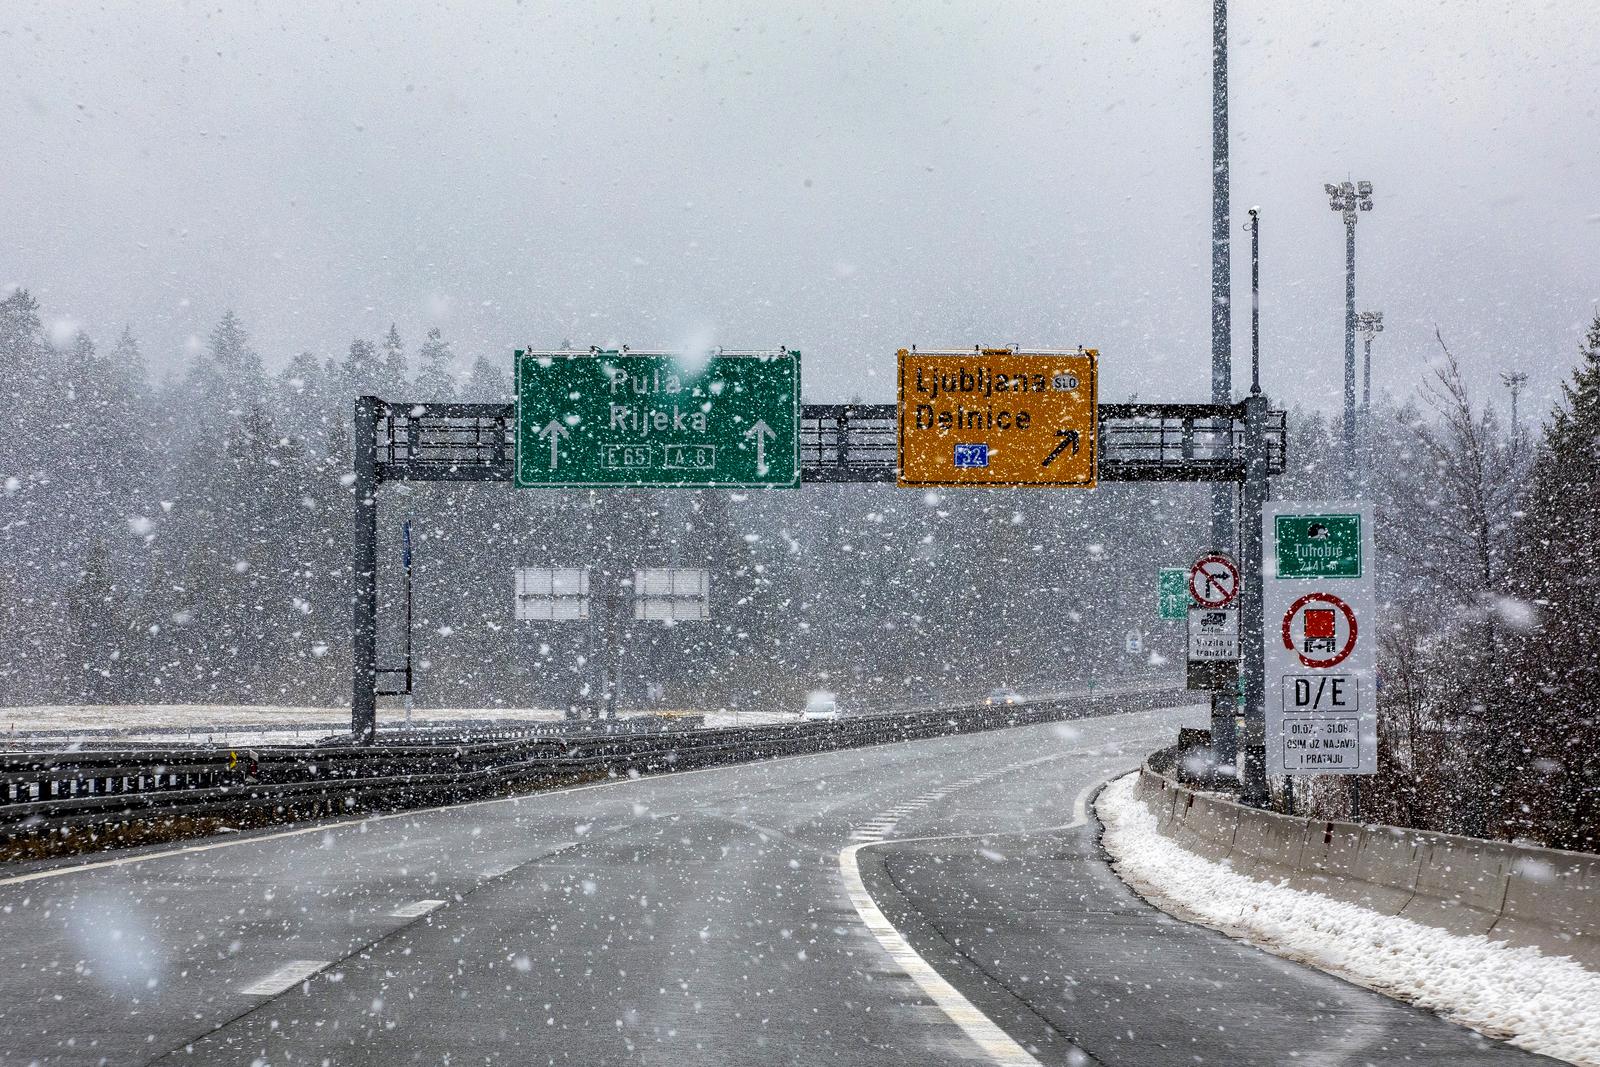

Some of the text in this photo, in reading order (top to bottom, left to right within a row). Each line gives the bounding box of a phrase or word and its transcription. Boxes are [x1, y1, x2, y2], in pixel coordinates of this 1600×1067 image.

[610, 368, 681, 394] Pula
[916, 367, 1076, 398] Ljubljana SLO
[610, 404, 706, 437] Rijeka
[916, 404, 1031, 430] Delnice
[608, 448, 644, 465] E 65
[675, 449, 705, 465] A 6
[963, 448, 982, 463] 32
[1296, 677, 1346, 709] D/E
[1287, 739, 1306, 749] OSIM
[1306, 754, 1343, 764] PRATNJU
